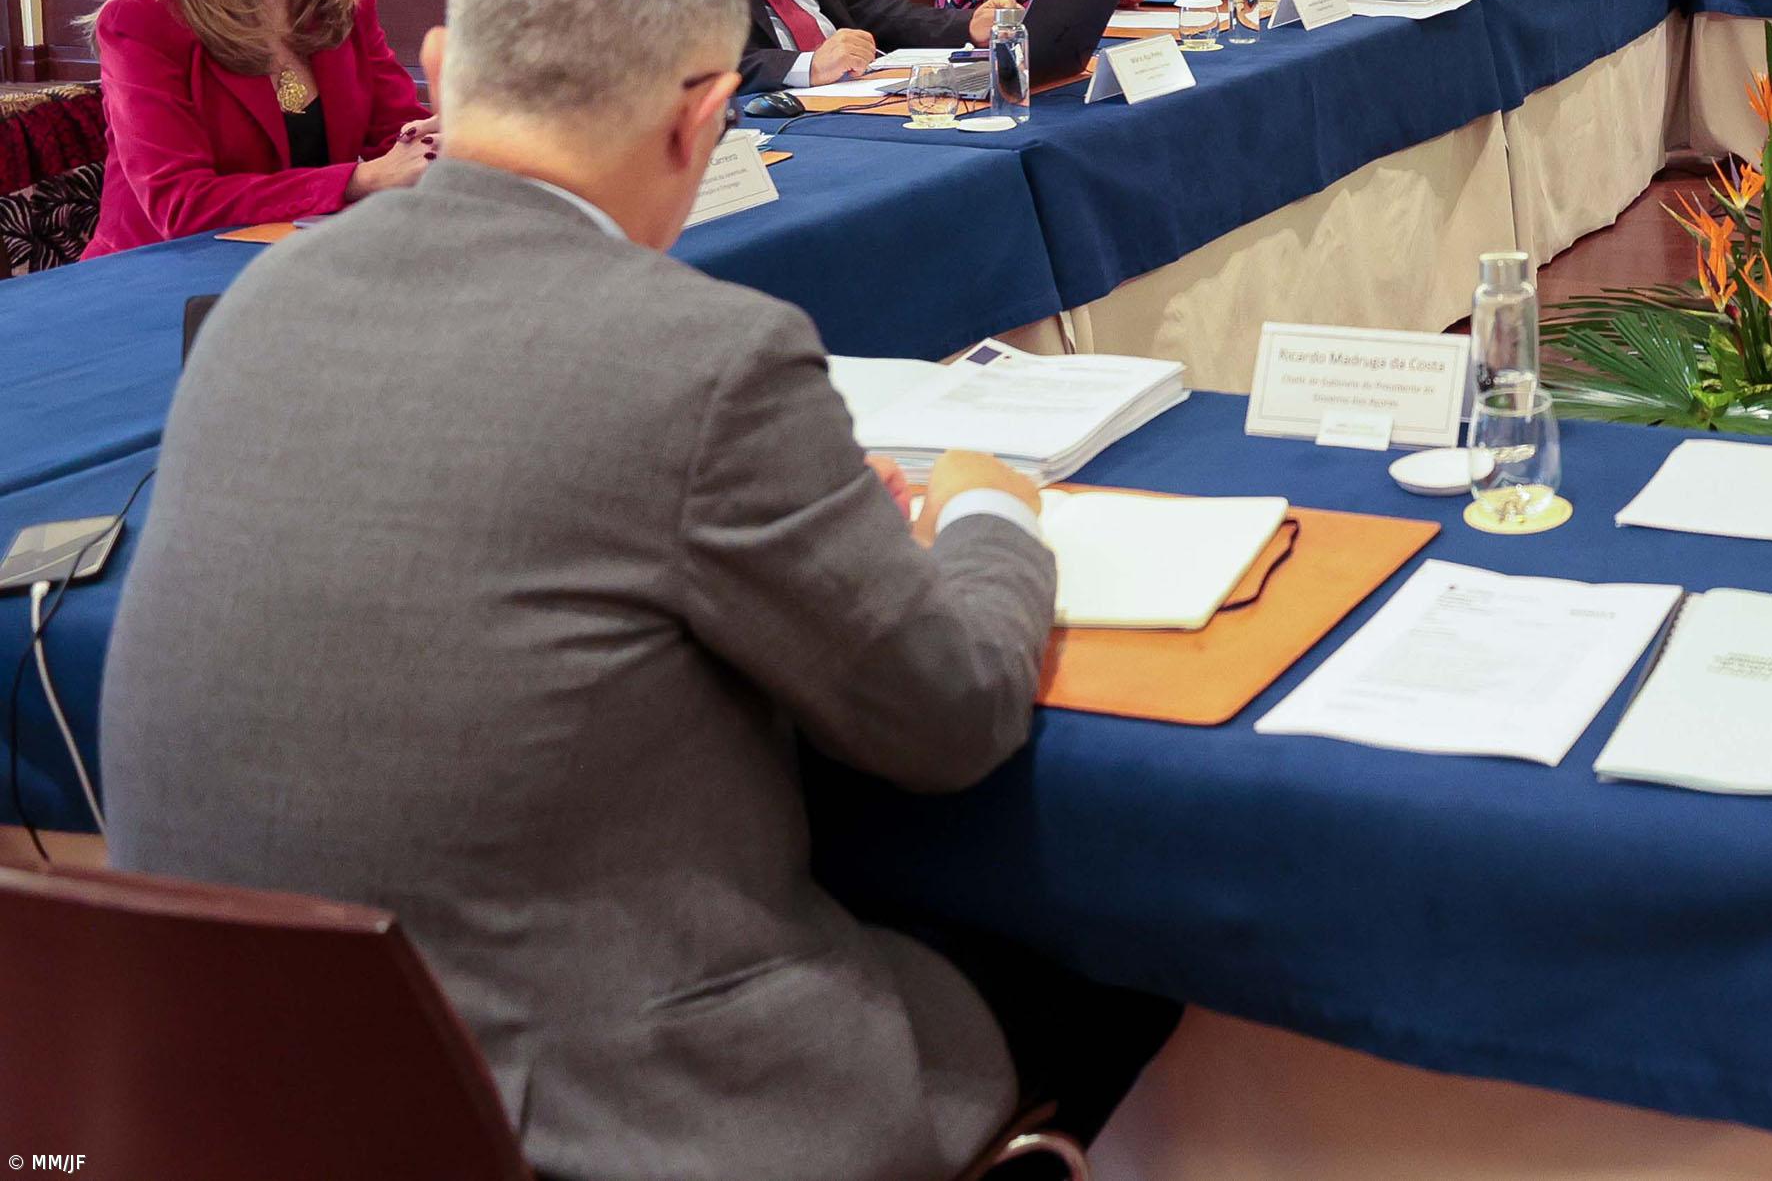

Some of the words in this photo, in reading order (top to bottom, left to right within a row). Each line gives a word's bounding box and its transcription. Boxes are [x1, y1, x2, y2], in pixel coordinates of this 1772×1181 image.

[1279, 349, 1326, 363] Ricardo
[1329, 351, 1386, 370] Madruga
[1408, 355, 1446, 371] Costa
